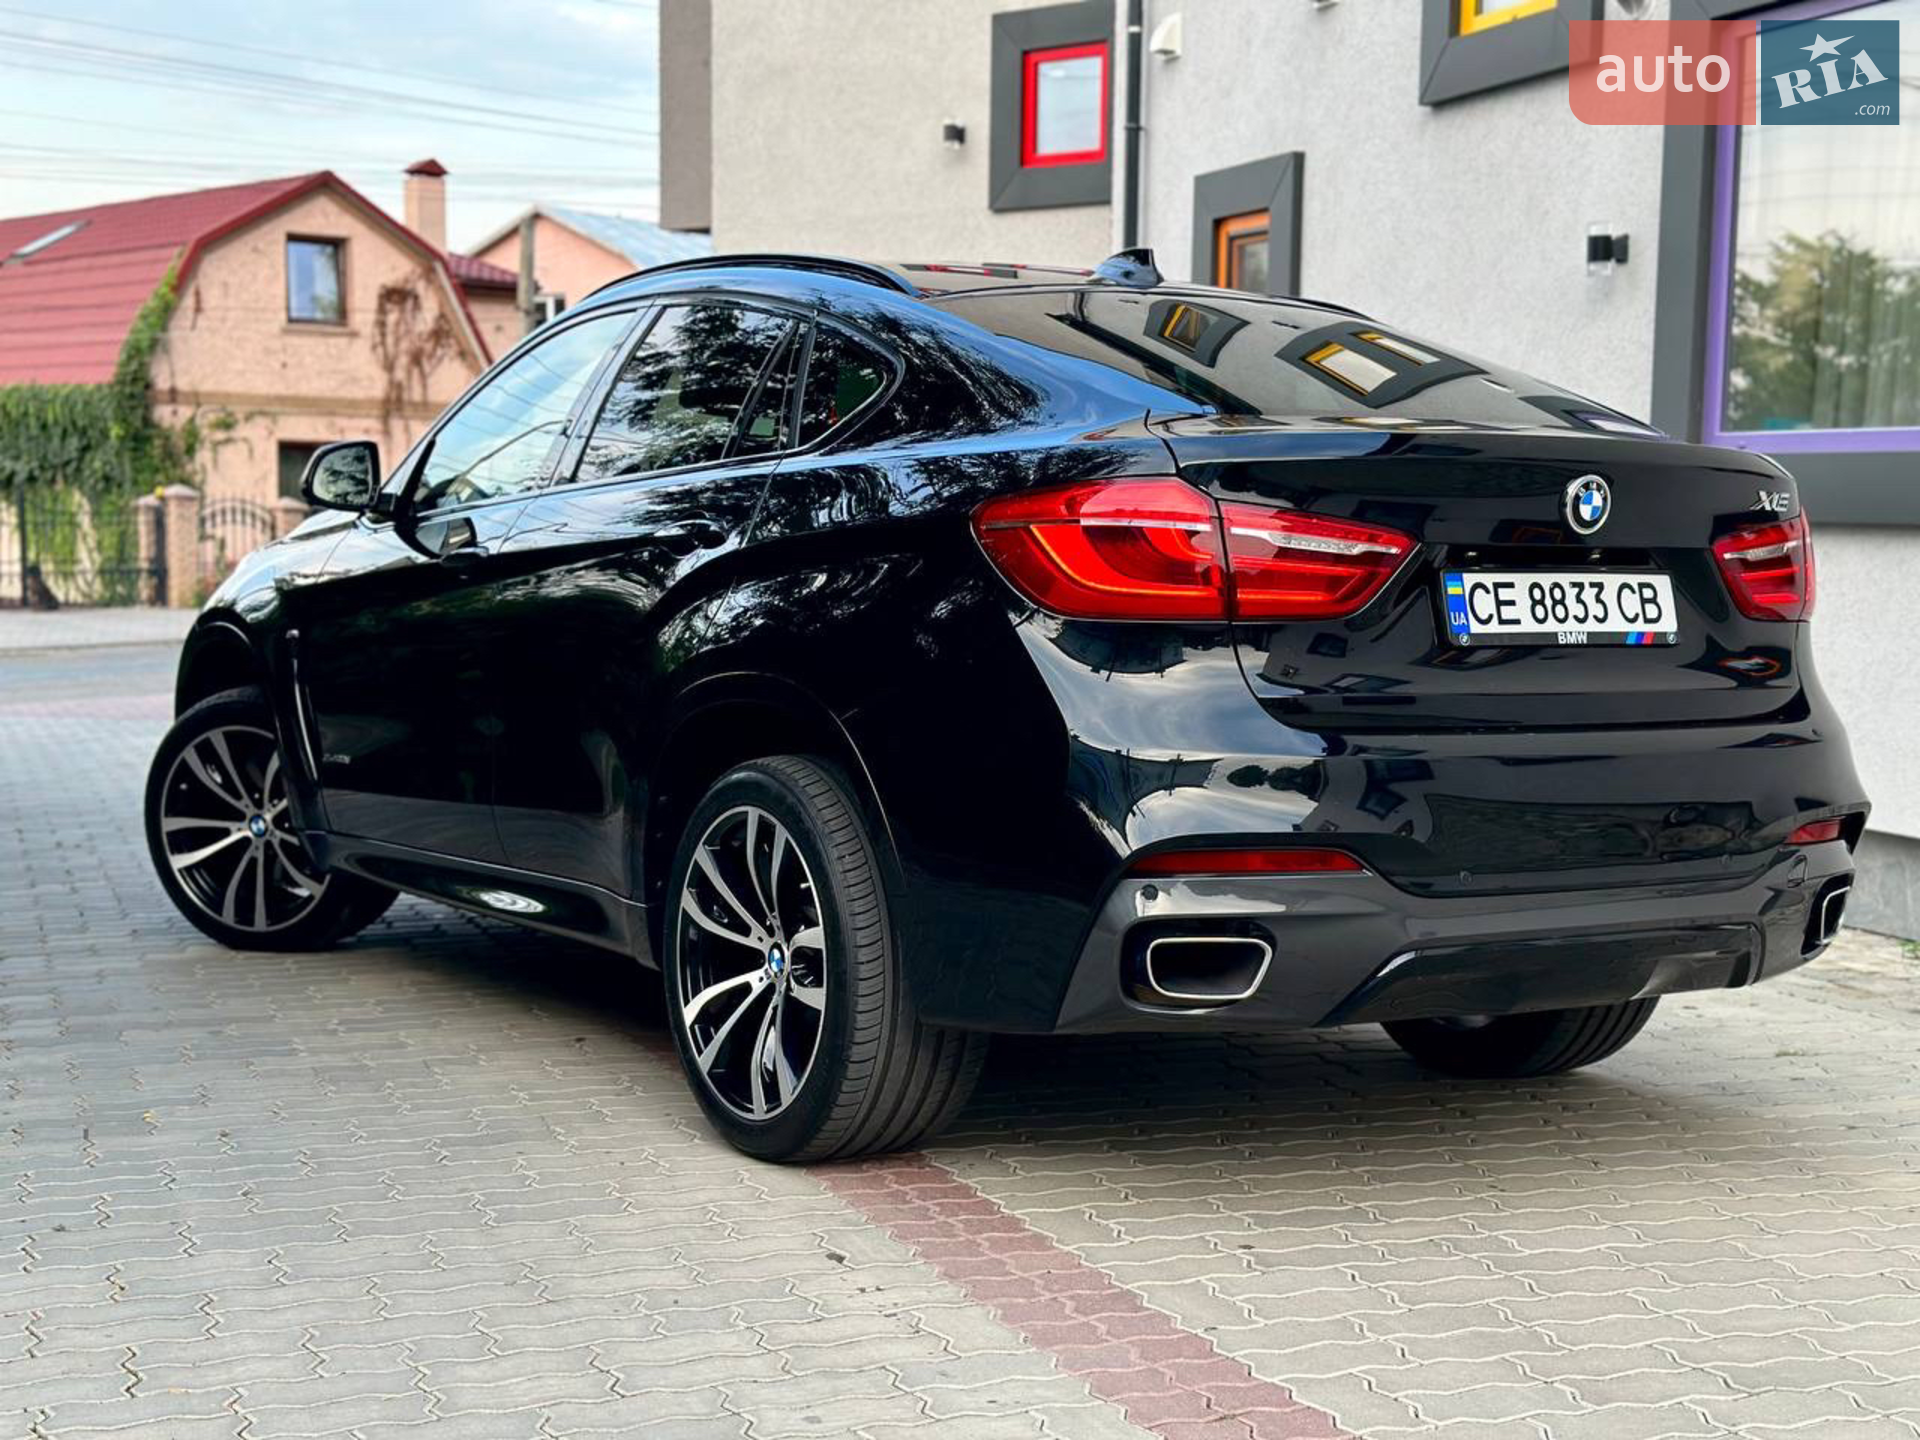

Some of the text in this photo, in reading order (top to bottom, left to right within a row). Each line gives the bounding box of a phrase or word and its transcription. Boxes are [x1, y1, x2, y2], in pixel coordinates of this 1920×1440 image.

[1468, 581, 1663, 625] CE 8833 CB
[1450, 611, 1468, 625] UA
[1557, 631, 1588, 645] BMW
